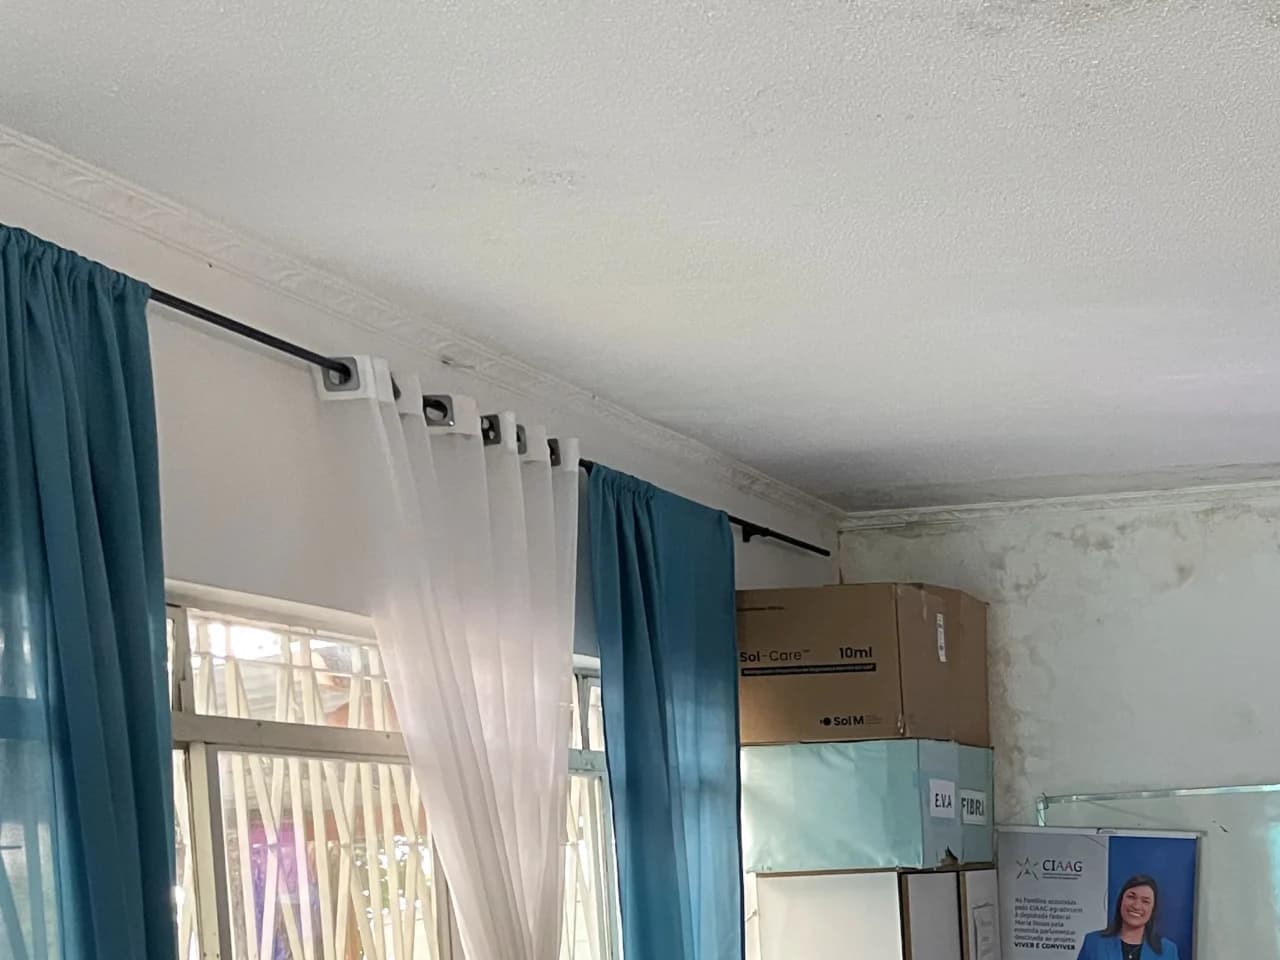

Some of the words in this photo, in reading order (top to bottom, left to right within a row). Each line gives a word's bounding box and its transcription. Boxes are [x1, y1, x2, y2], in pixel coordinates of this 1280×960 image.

[839, 646, 873, 660] 10ml
[1042, 859, 1083, 873] CIAAG
[1014, 941, 1035, 949] VIVER
[1041, 942, 1076, 951] CONVIVER
